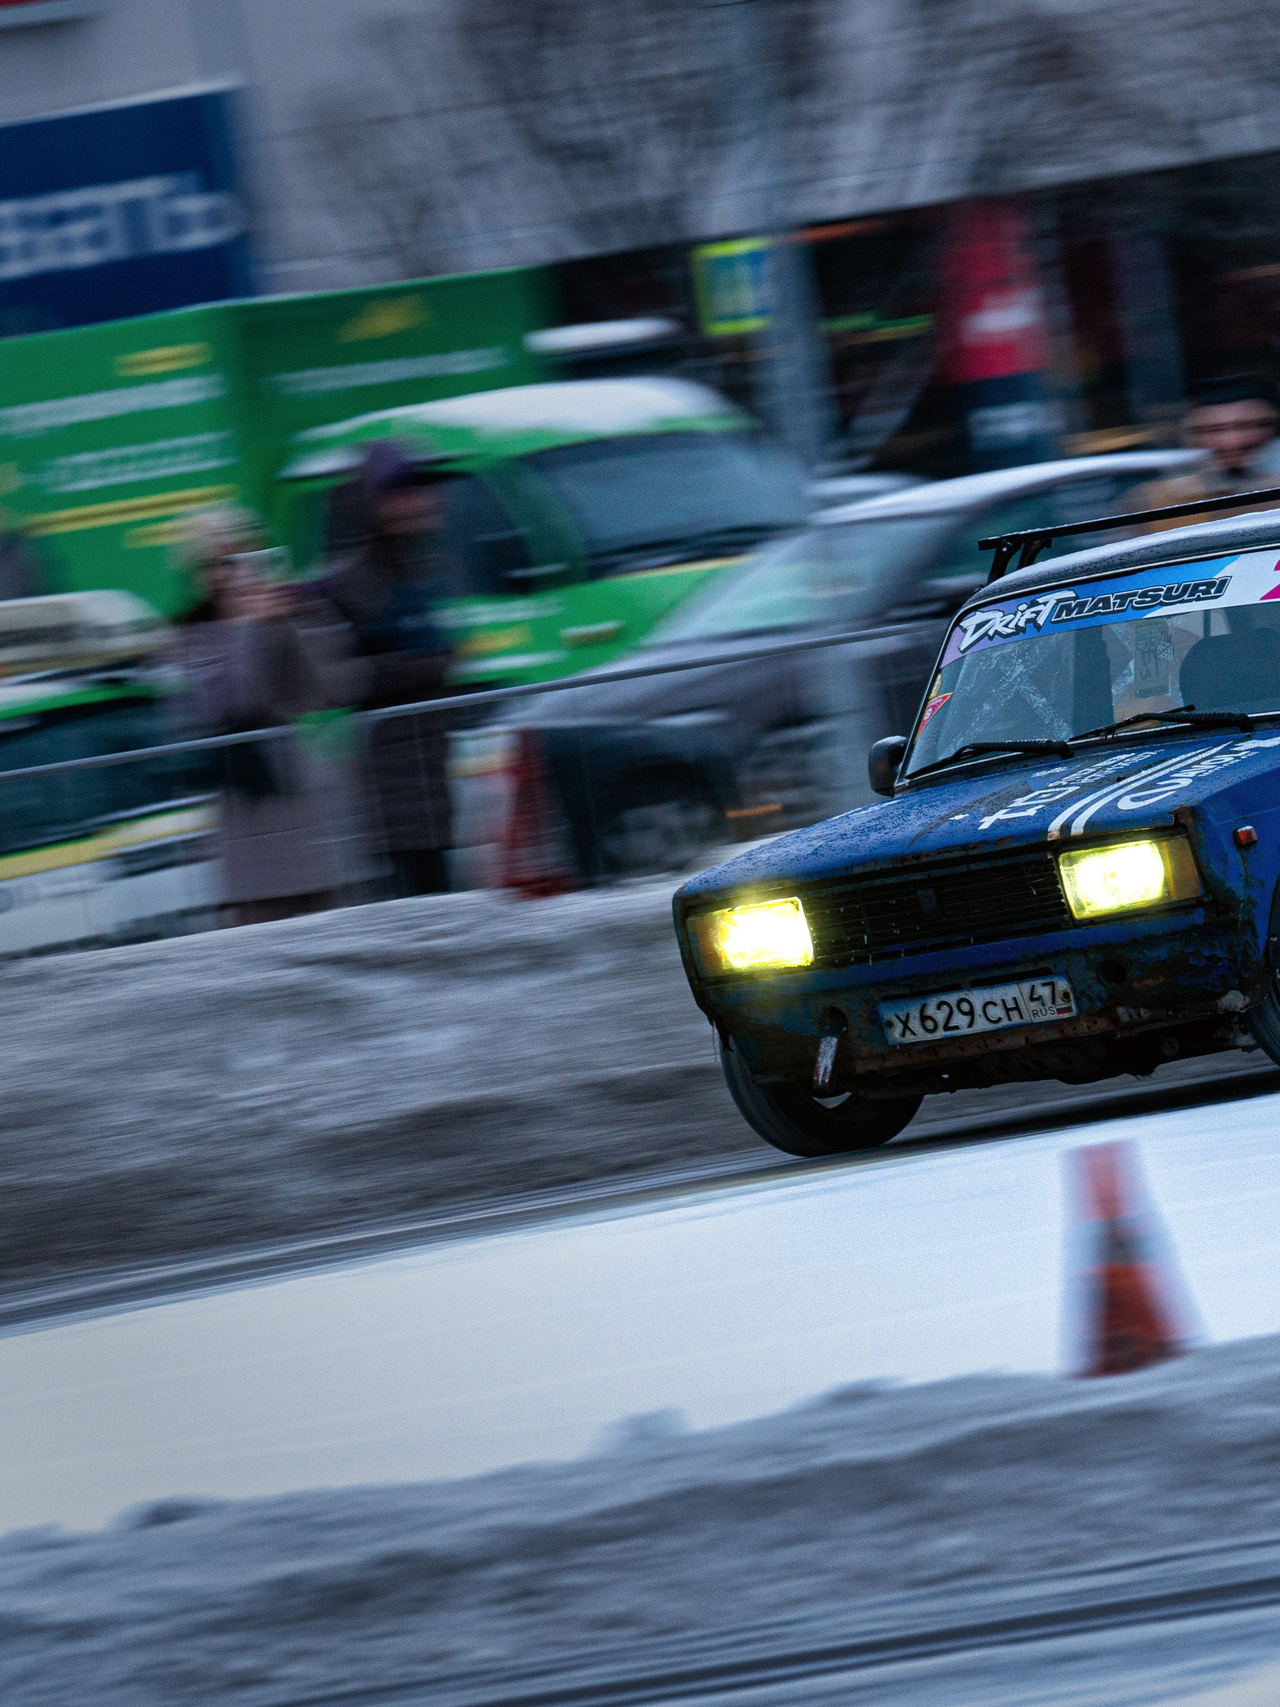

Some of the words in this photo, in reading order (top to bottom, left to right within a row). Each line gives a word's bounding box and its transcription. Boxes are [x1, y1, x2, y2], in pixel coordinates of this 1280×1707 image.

[1050, 576, 1233, 622] MATSURI
[1029, 981, 1057, 1007] 47
[1031, 1006, 1057, 1019] RUS
